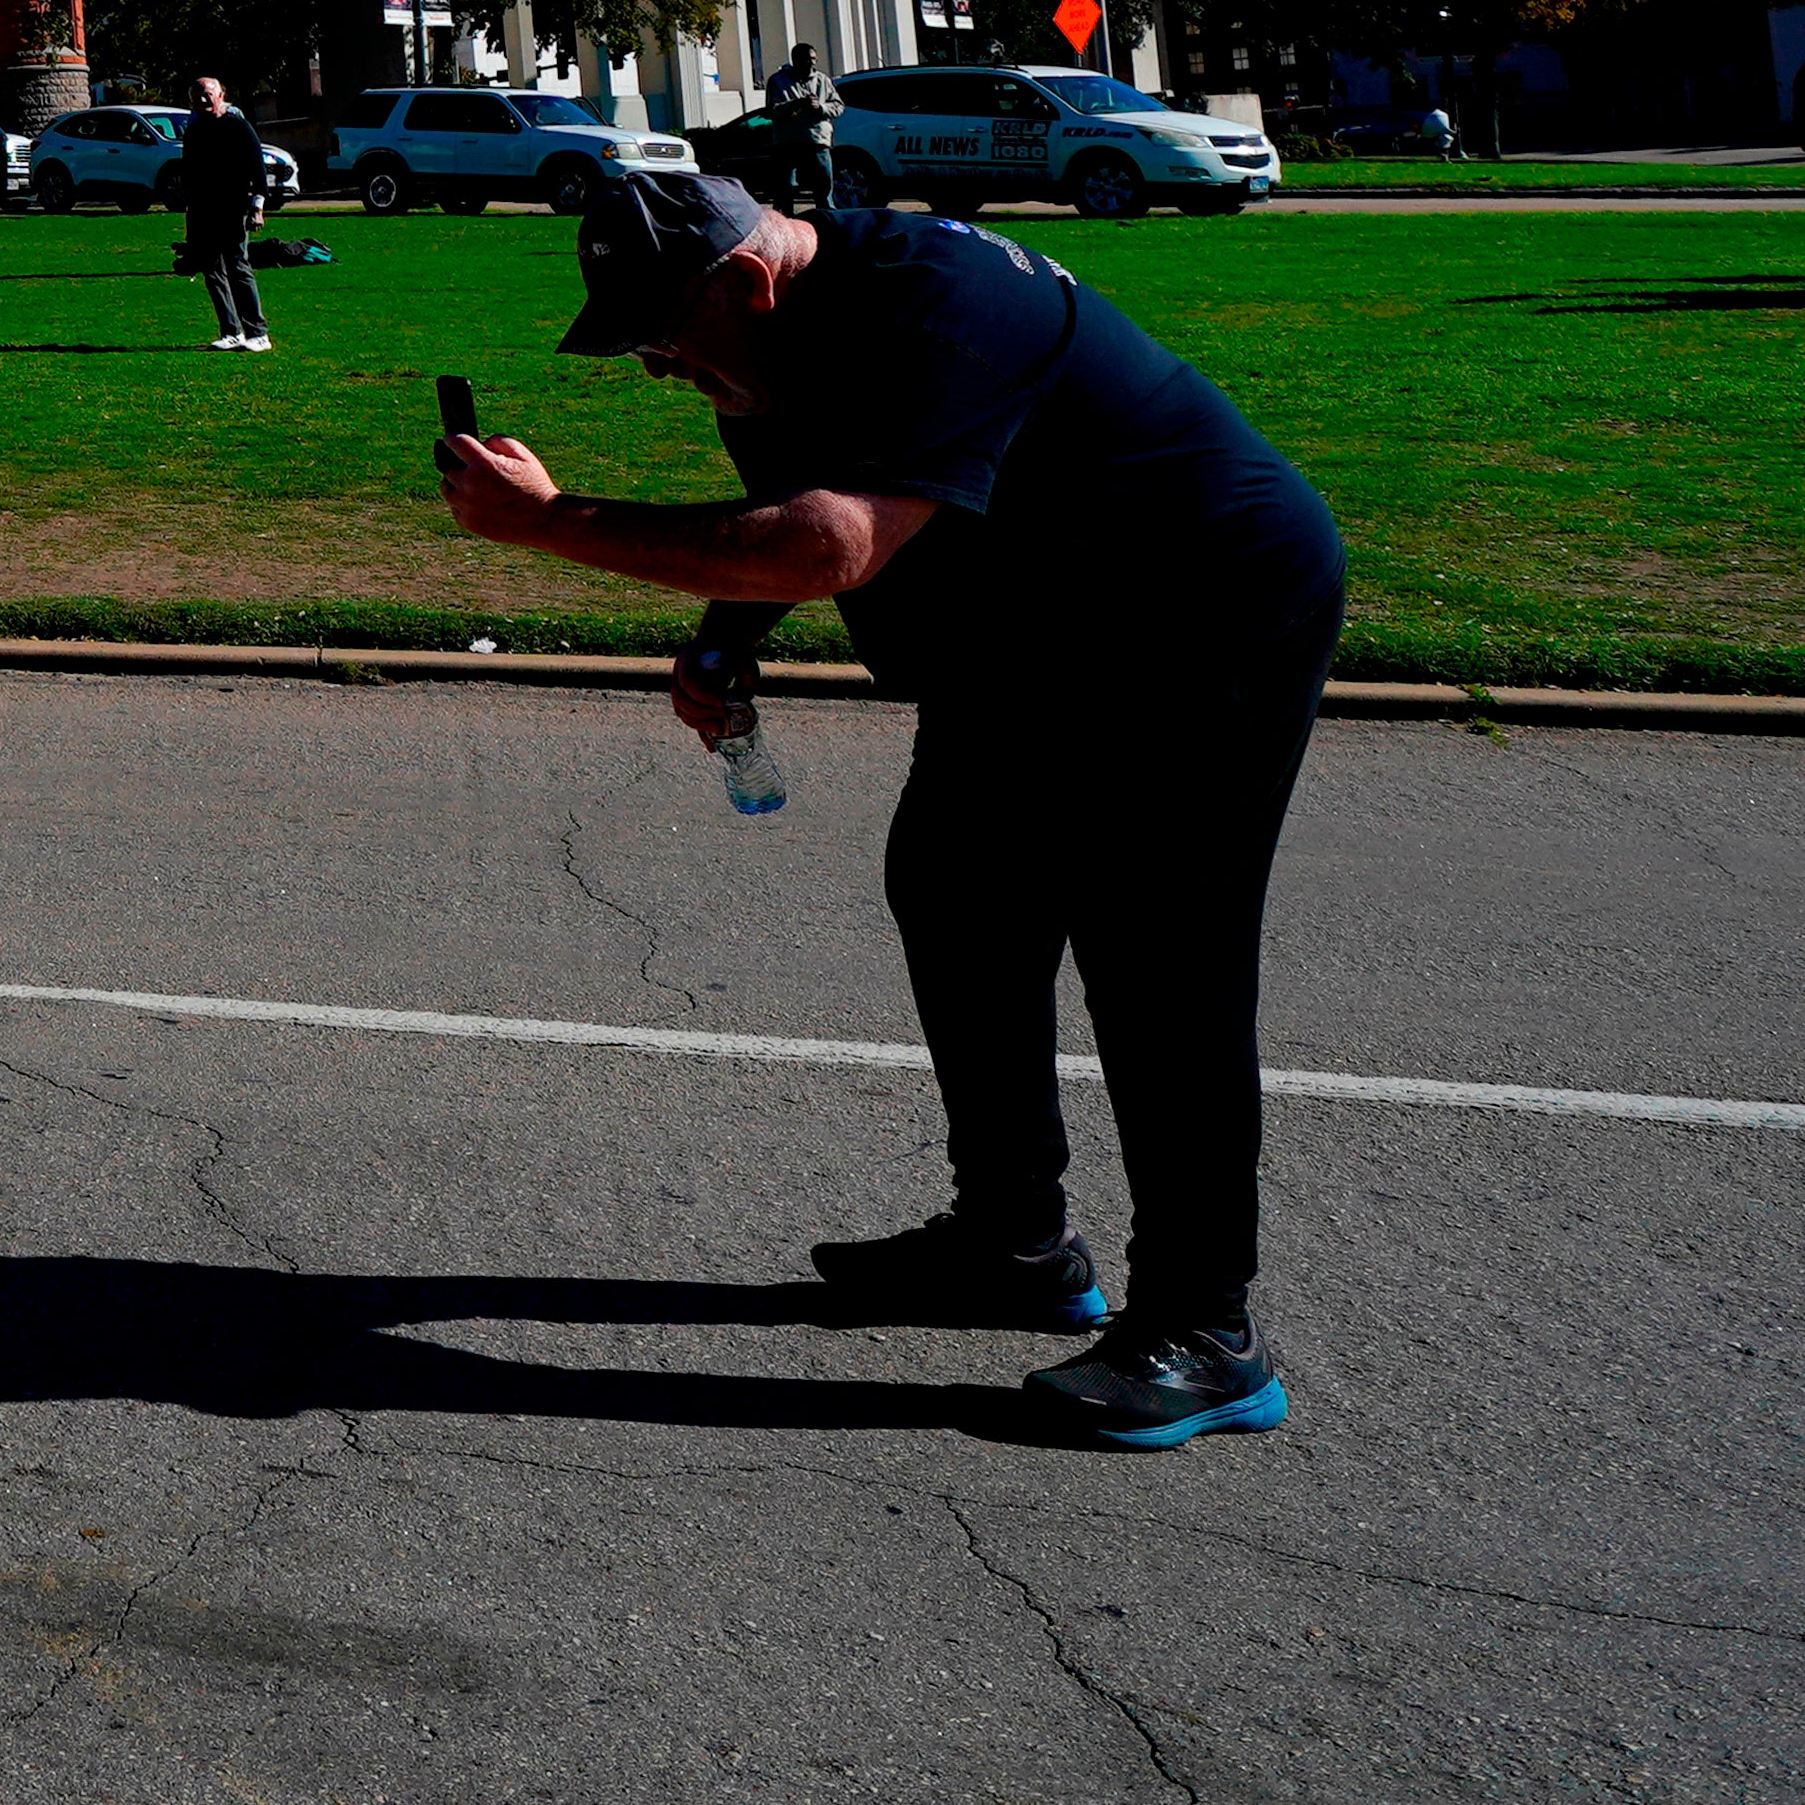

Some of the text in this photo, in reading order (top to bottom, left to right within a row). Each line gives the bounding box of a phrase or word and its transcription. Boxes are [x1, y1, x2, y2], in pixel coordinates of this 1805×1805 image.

[994, 122, 1046, 134] KRLD
[894, 135, 980, 156] ALL NEWS
[993, 145, 1046, 158] 1080
